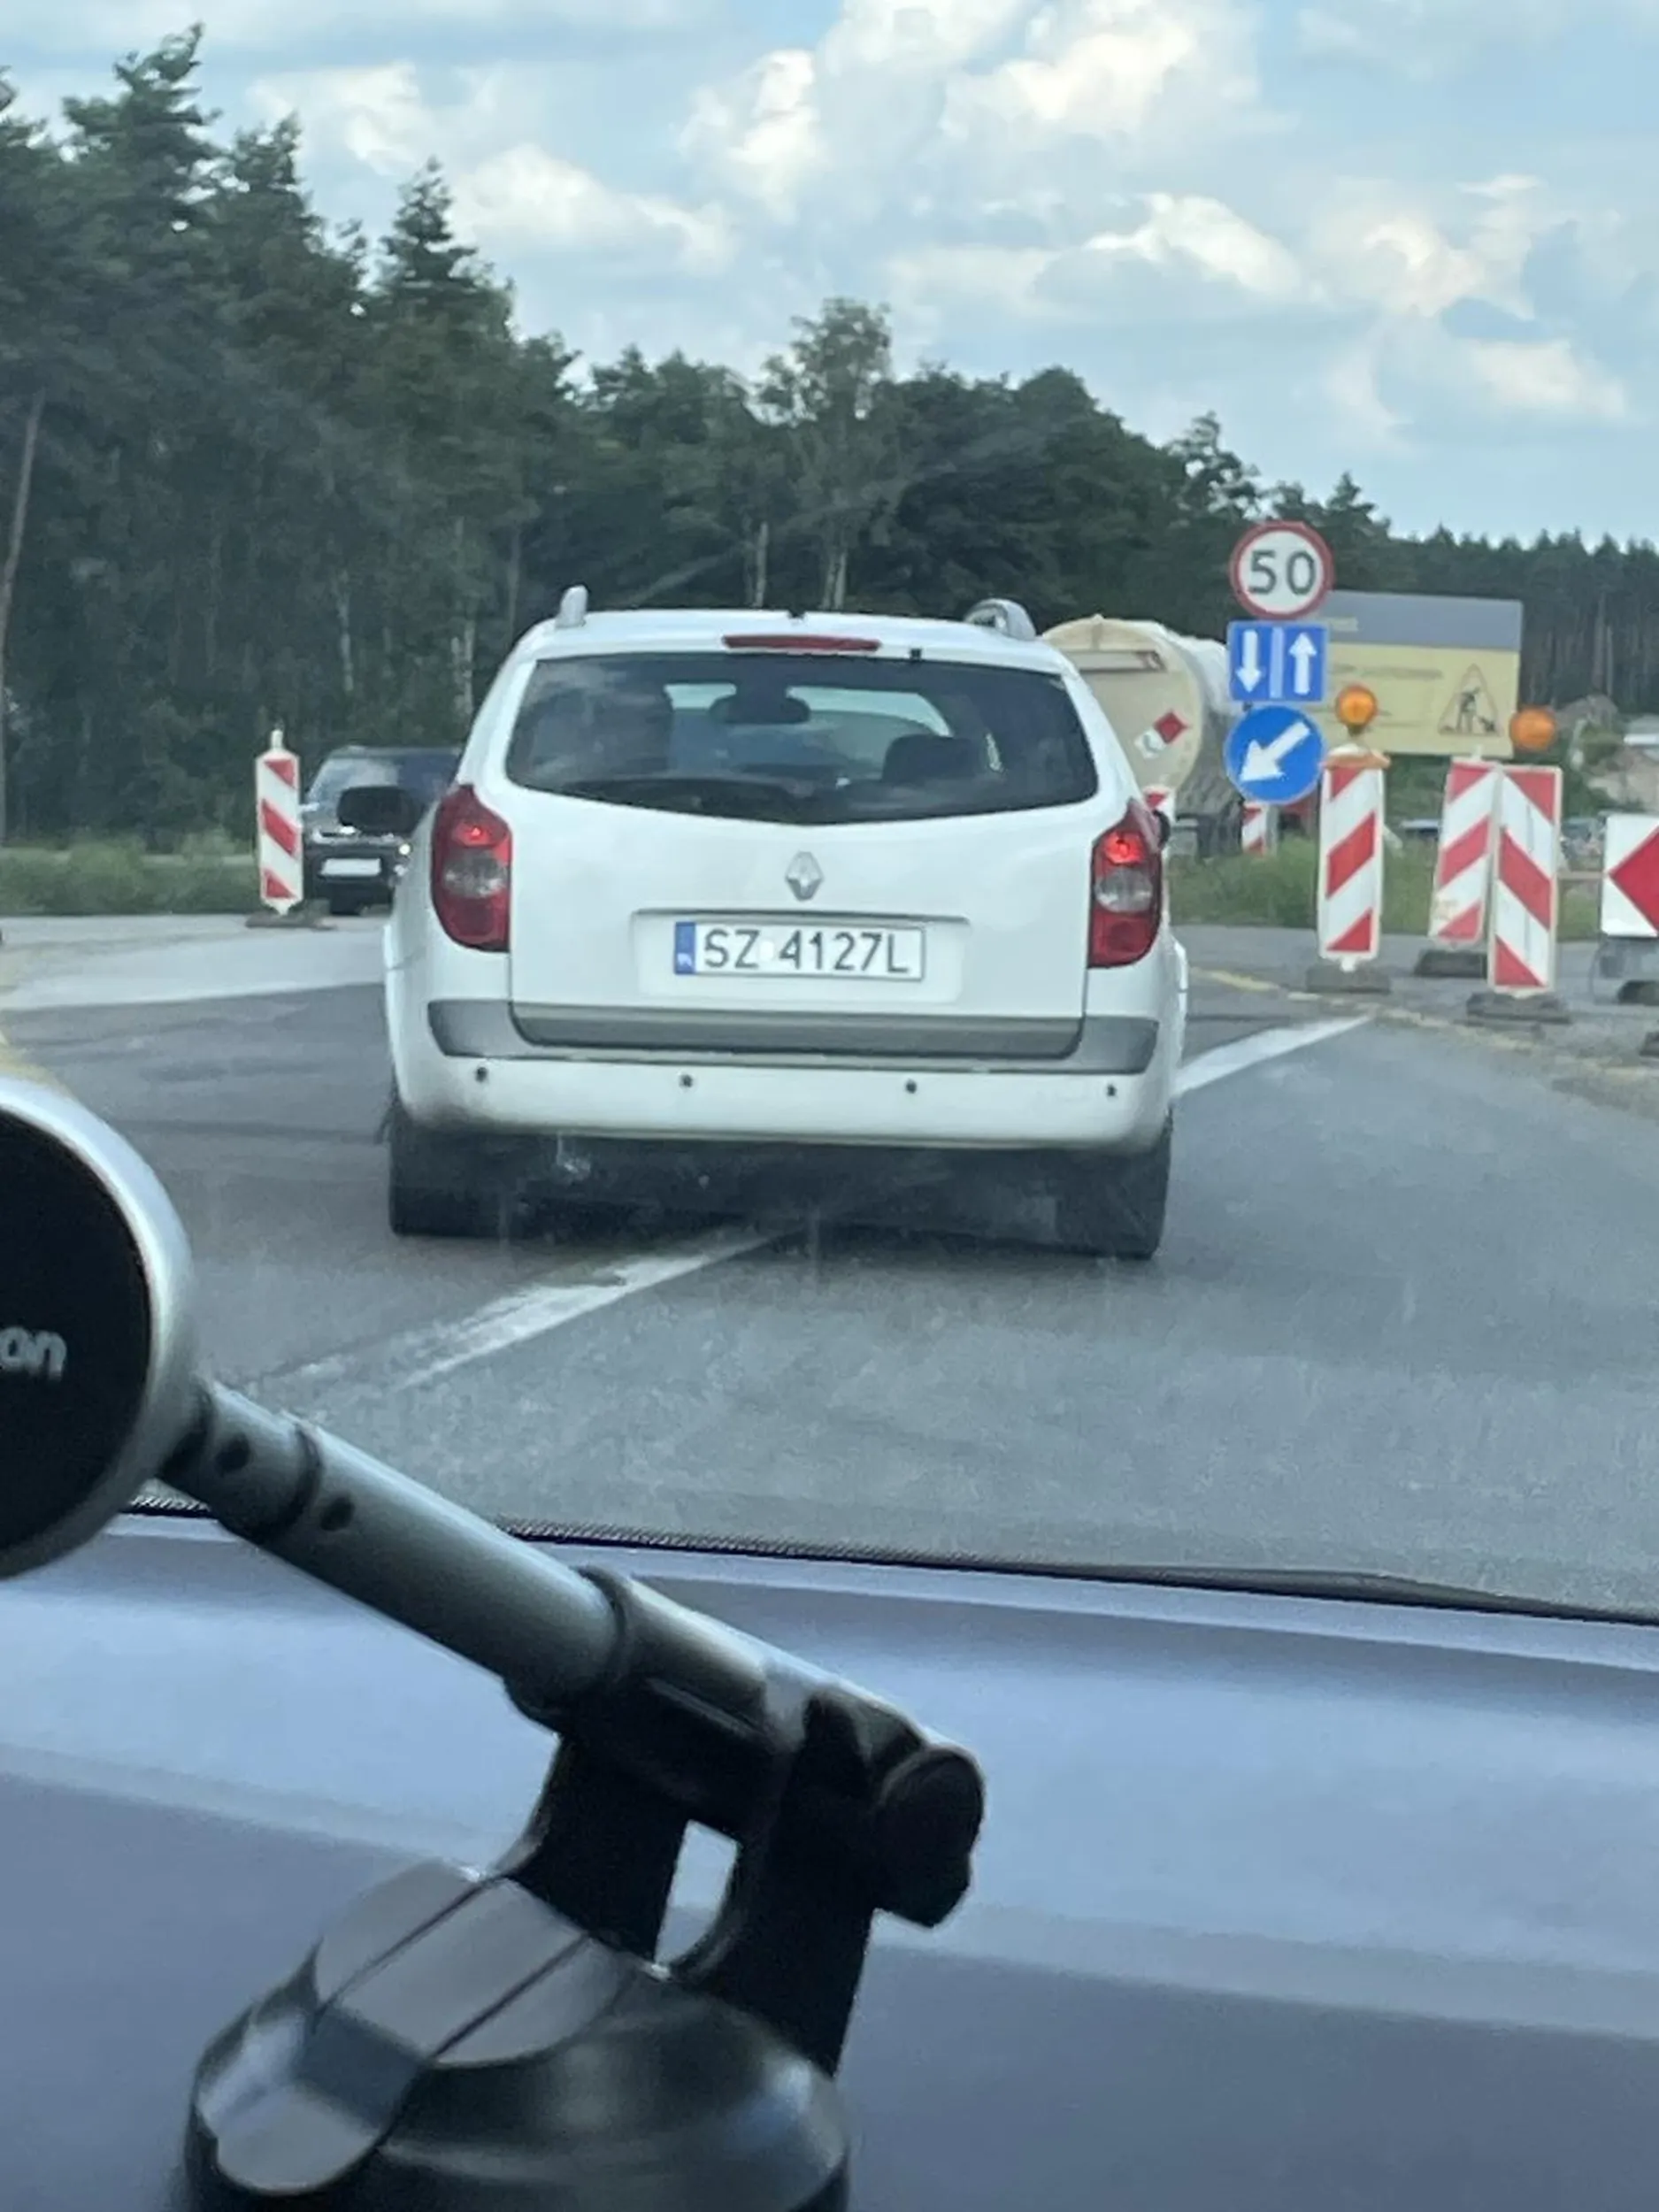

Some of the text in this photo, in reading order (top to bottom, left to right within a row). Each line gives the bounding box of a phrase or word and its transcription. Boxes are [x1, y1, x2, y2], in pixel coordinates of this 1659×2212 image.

[1249, 550, 1316, 595] 50
[703, 928, 910, 973] SZ 4127L
